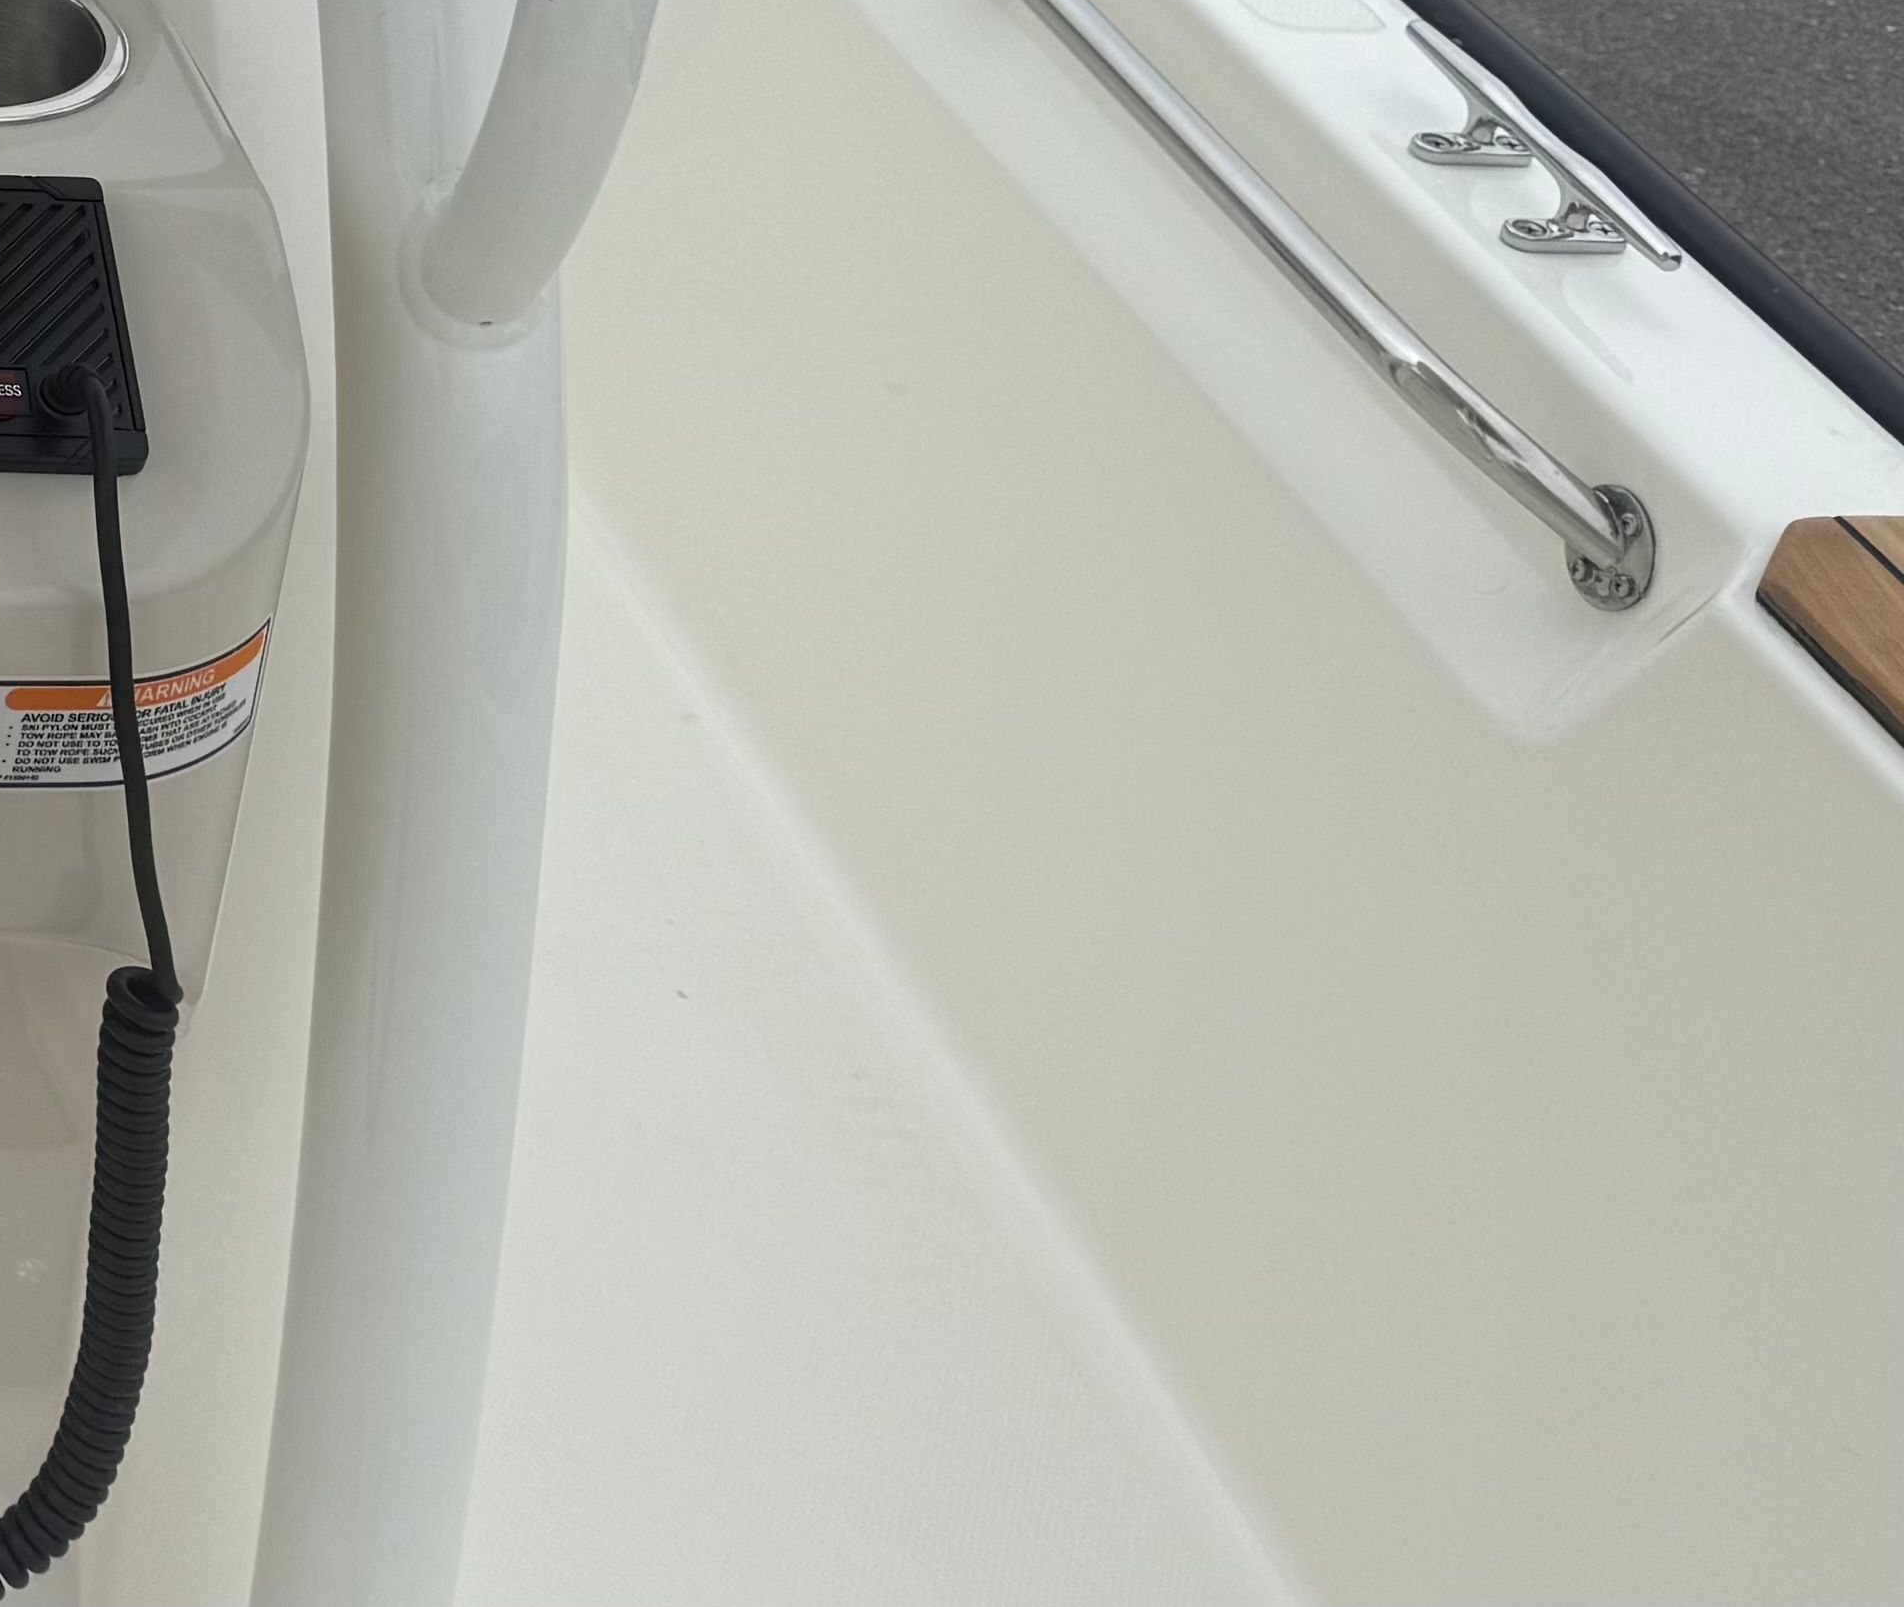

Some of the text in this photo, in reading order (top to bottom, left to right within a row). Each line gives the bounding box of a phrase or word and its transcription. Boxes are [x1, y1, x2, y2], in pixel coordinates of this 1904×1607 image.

[155, 699, 189, 715] FATAL
[190, 682, 227, 706] INJURY
[21, 712, 114, 723] AVOID SERIO
[12, 765, 62, 774] RUNNING
